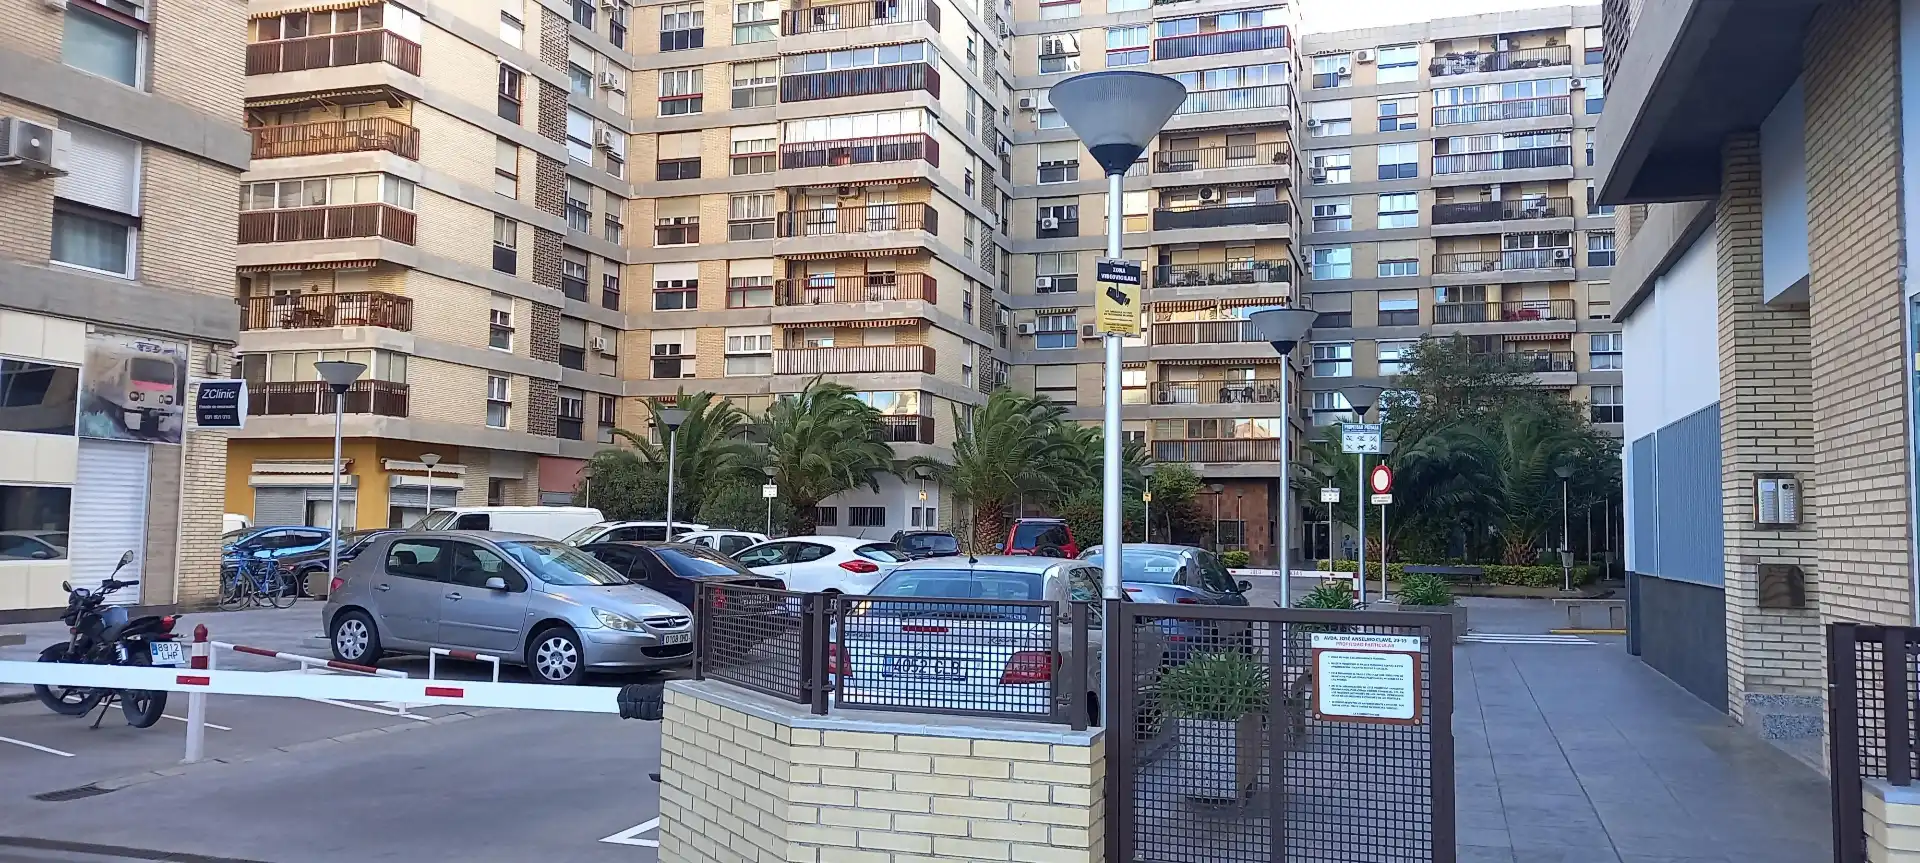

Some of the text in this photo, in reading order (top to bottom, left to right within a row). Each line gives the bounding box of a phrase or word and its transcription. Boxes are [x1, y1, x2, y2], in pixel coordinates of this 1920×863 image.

[202, 389, 235, 399] ZClinic
[157, 643, 180, 652] 8912
[161, 651, 178, 660] LHP
